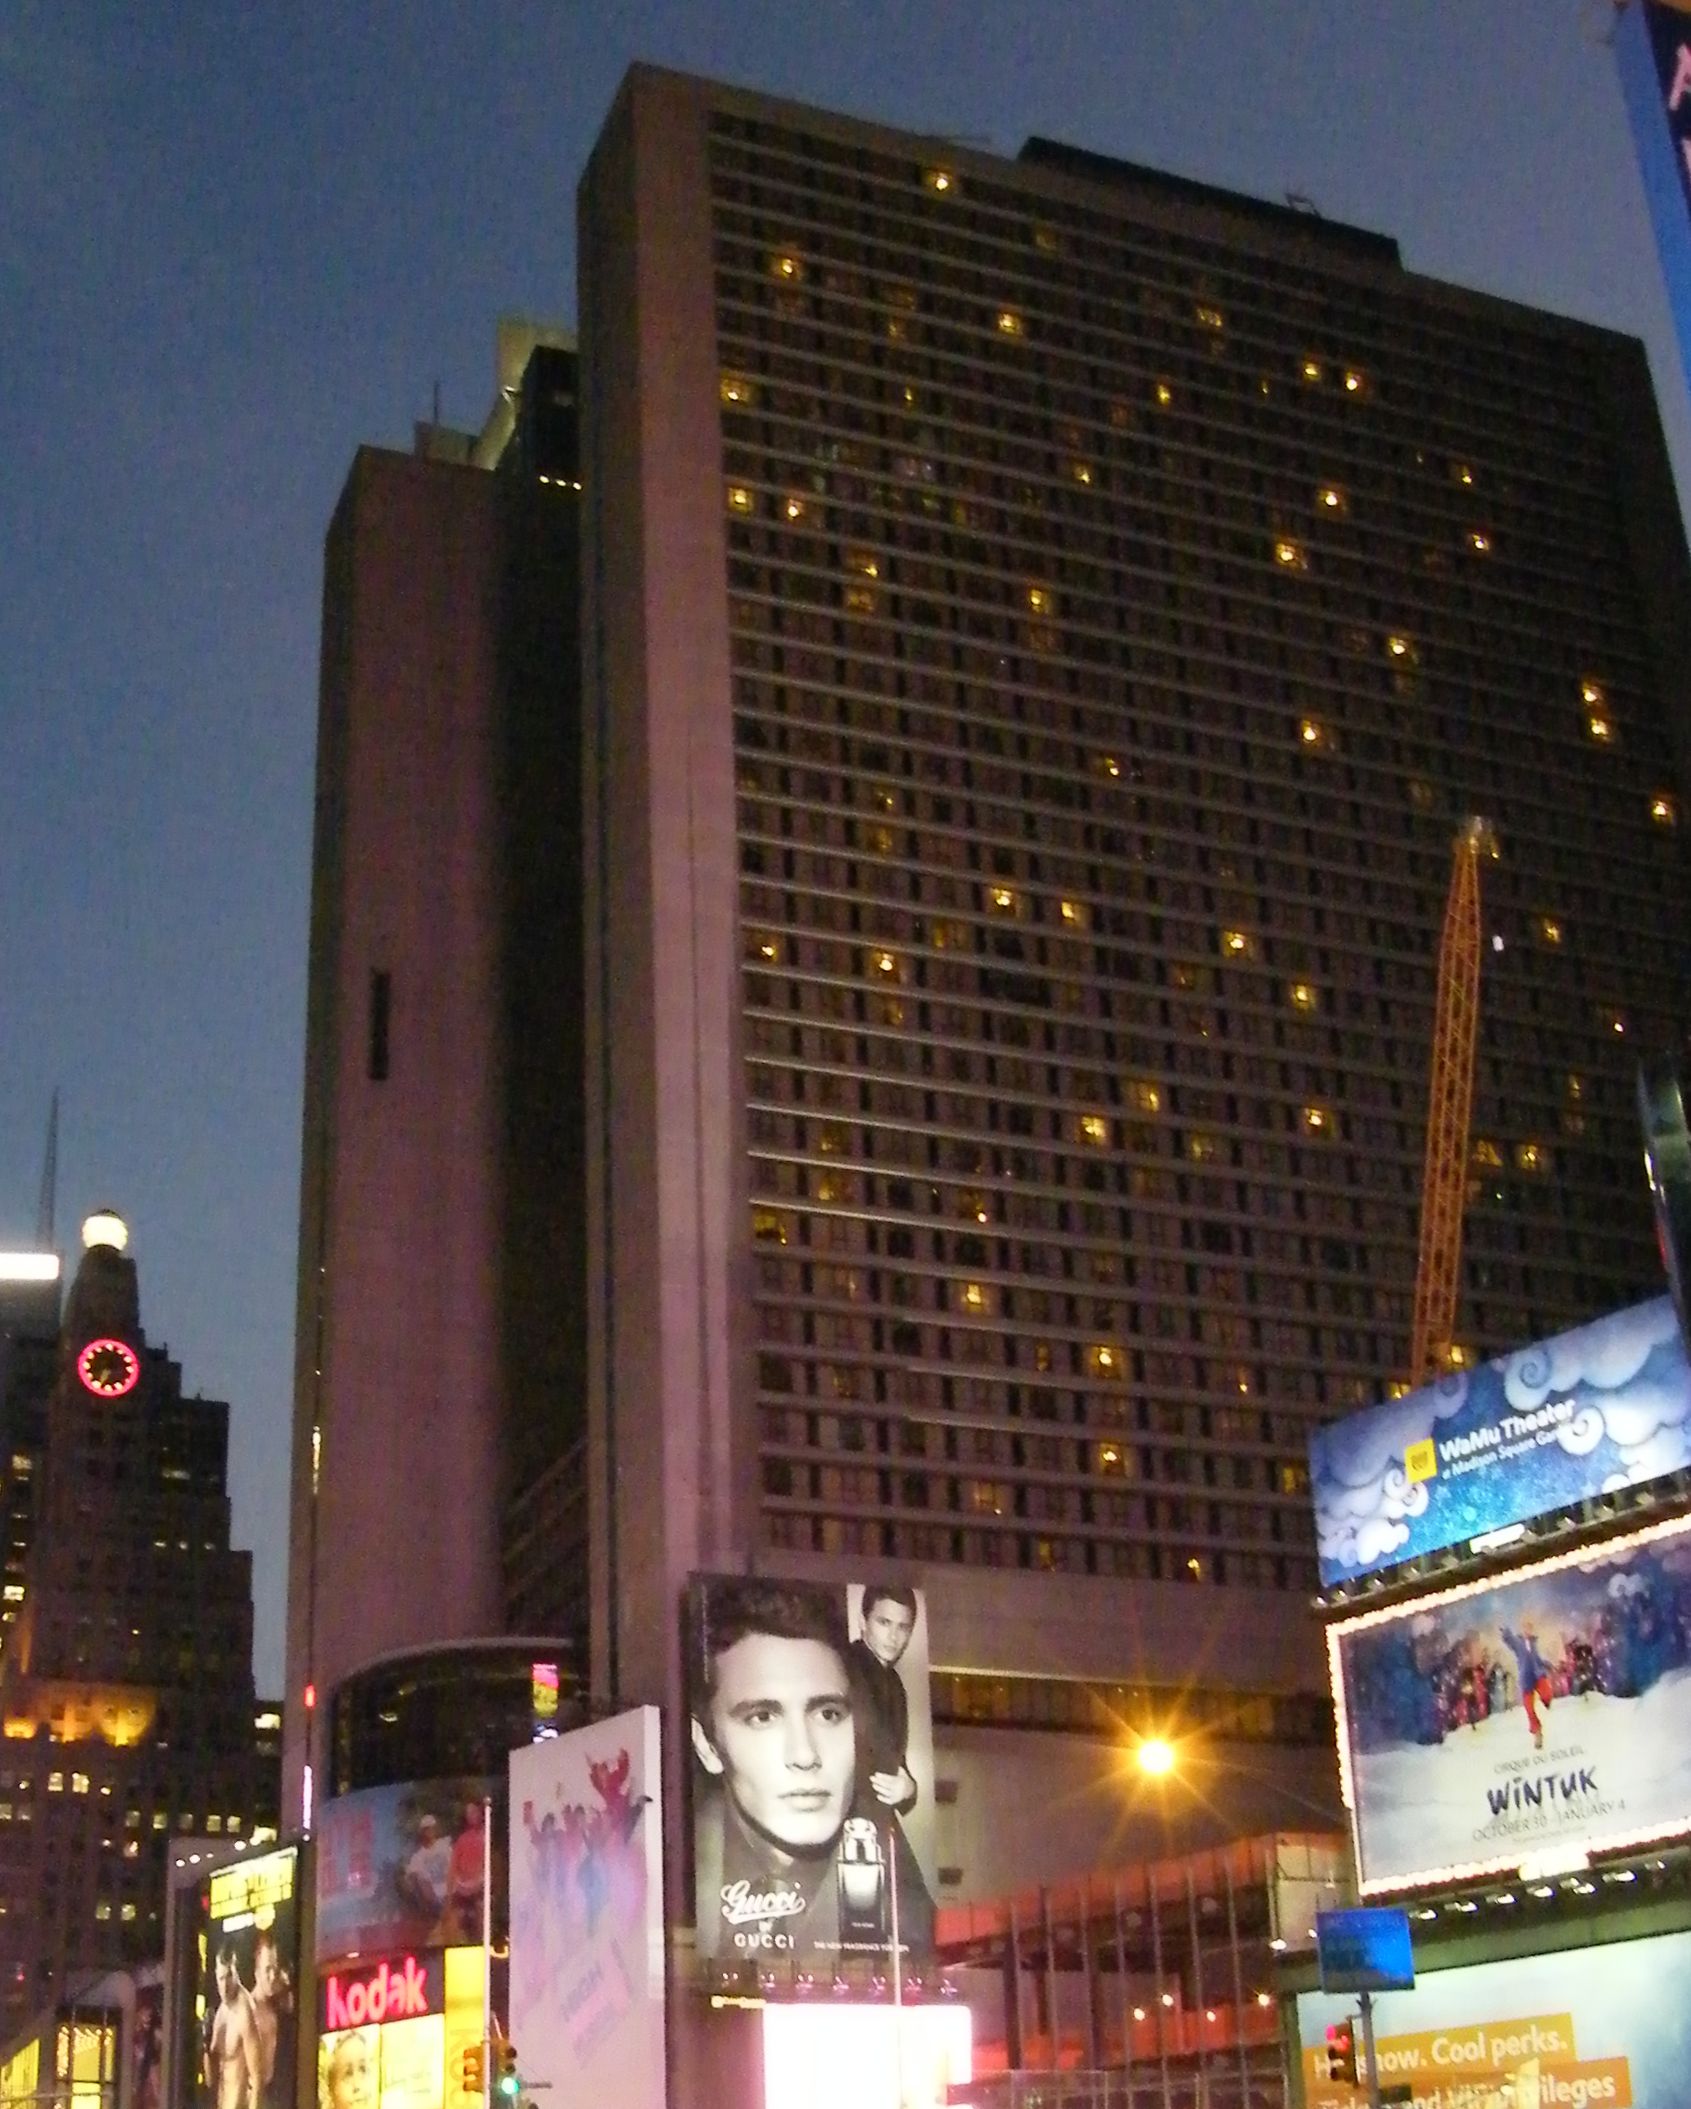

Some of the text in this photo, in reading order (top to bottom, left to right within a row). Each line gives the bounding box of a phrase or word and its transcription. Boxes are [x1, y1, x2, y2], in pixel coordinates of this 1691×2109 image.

[1439, 1399, 1576, 1462] WaMu Theater
[734, 1933, 794, 1949] GUCCI
[1431, 2031, 1486, 2064] Cool
[1491, 2024, 1568, 2067] perks.
